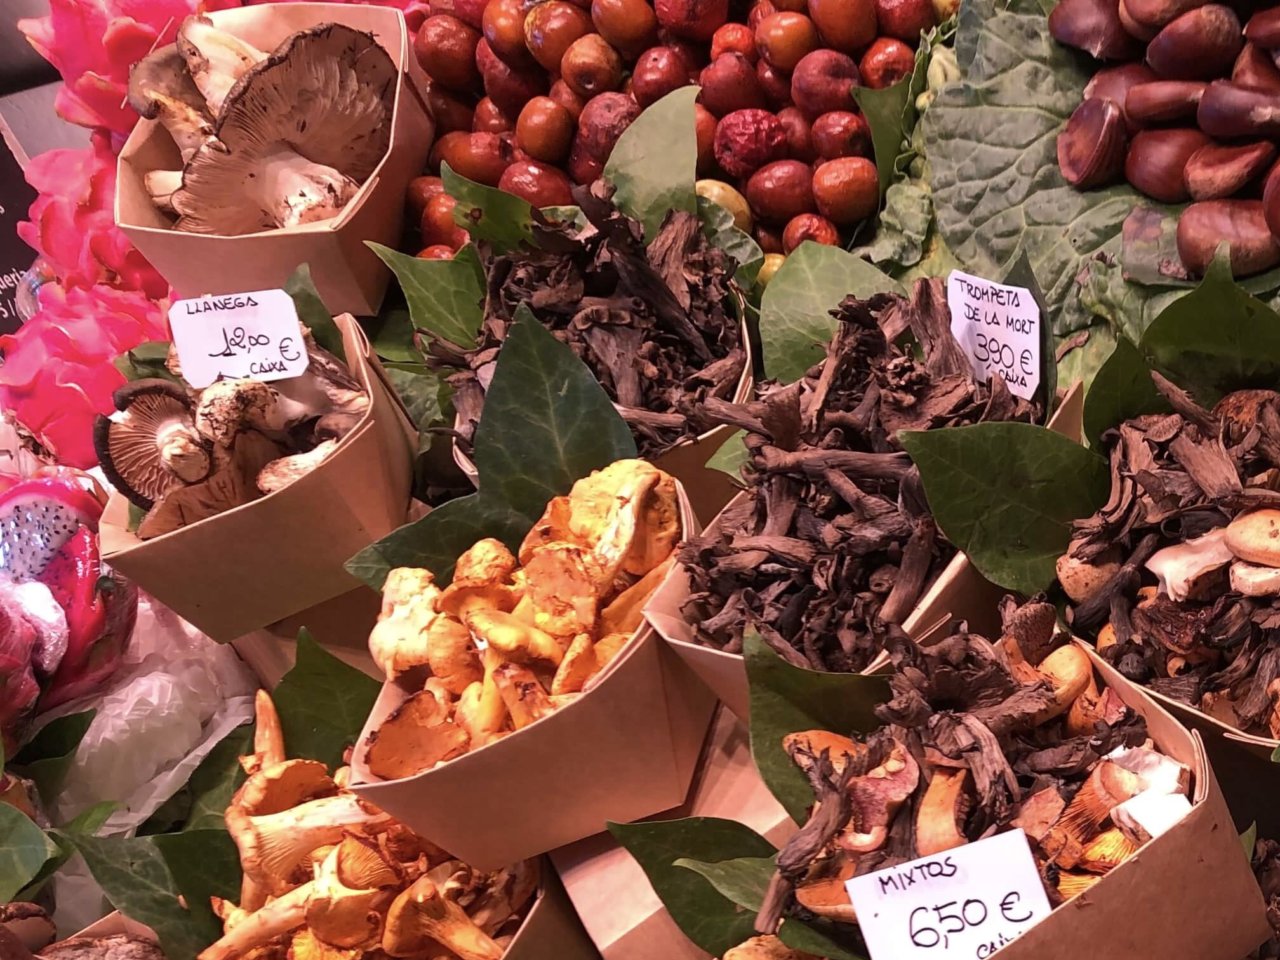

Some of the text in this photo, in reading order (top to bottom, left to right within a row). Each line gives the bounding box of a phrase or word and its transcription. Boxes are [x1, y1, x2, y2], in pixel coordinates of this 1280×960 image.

[186, 296, 259, 315] LLANEGA
[954, 278, 1020, 307] TROMPETA
[964, 302, 1036, 336] DE LA MORT
[278, 336, 301, 362] €
[1019, 348, 1034, 376] €
[877, 856, 958, 895] MIXTOS
[908, 890, 1034, 950] 6,50 €
